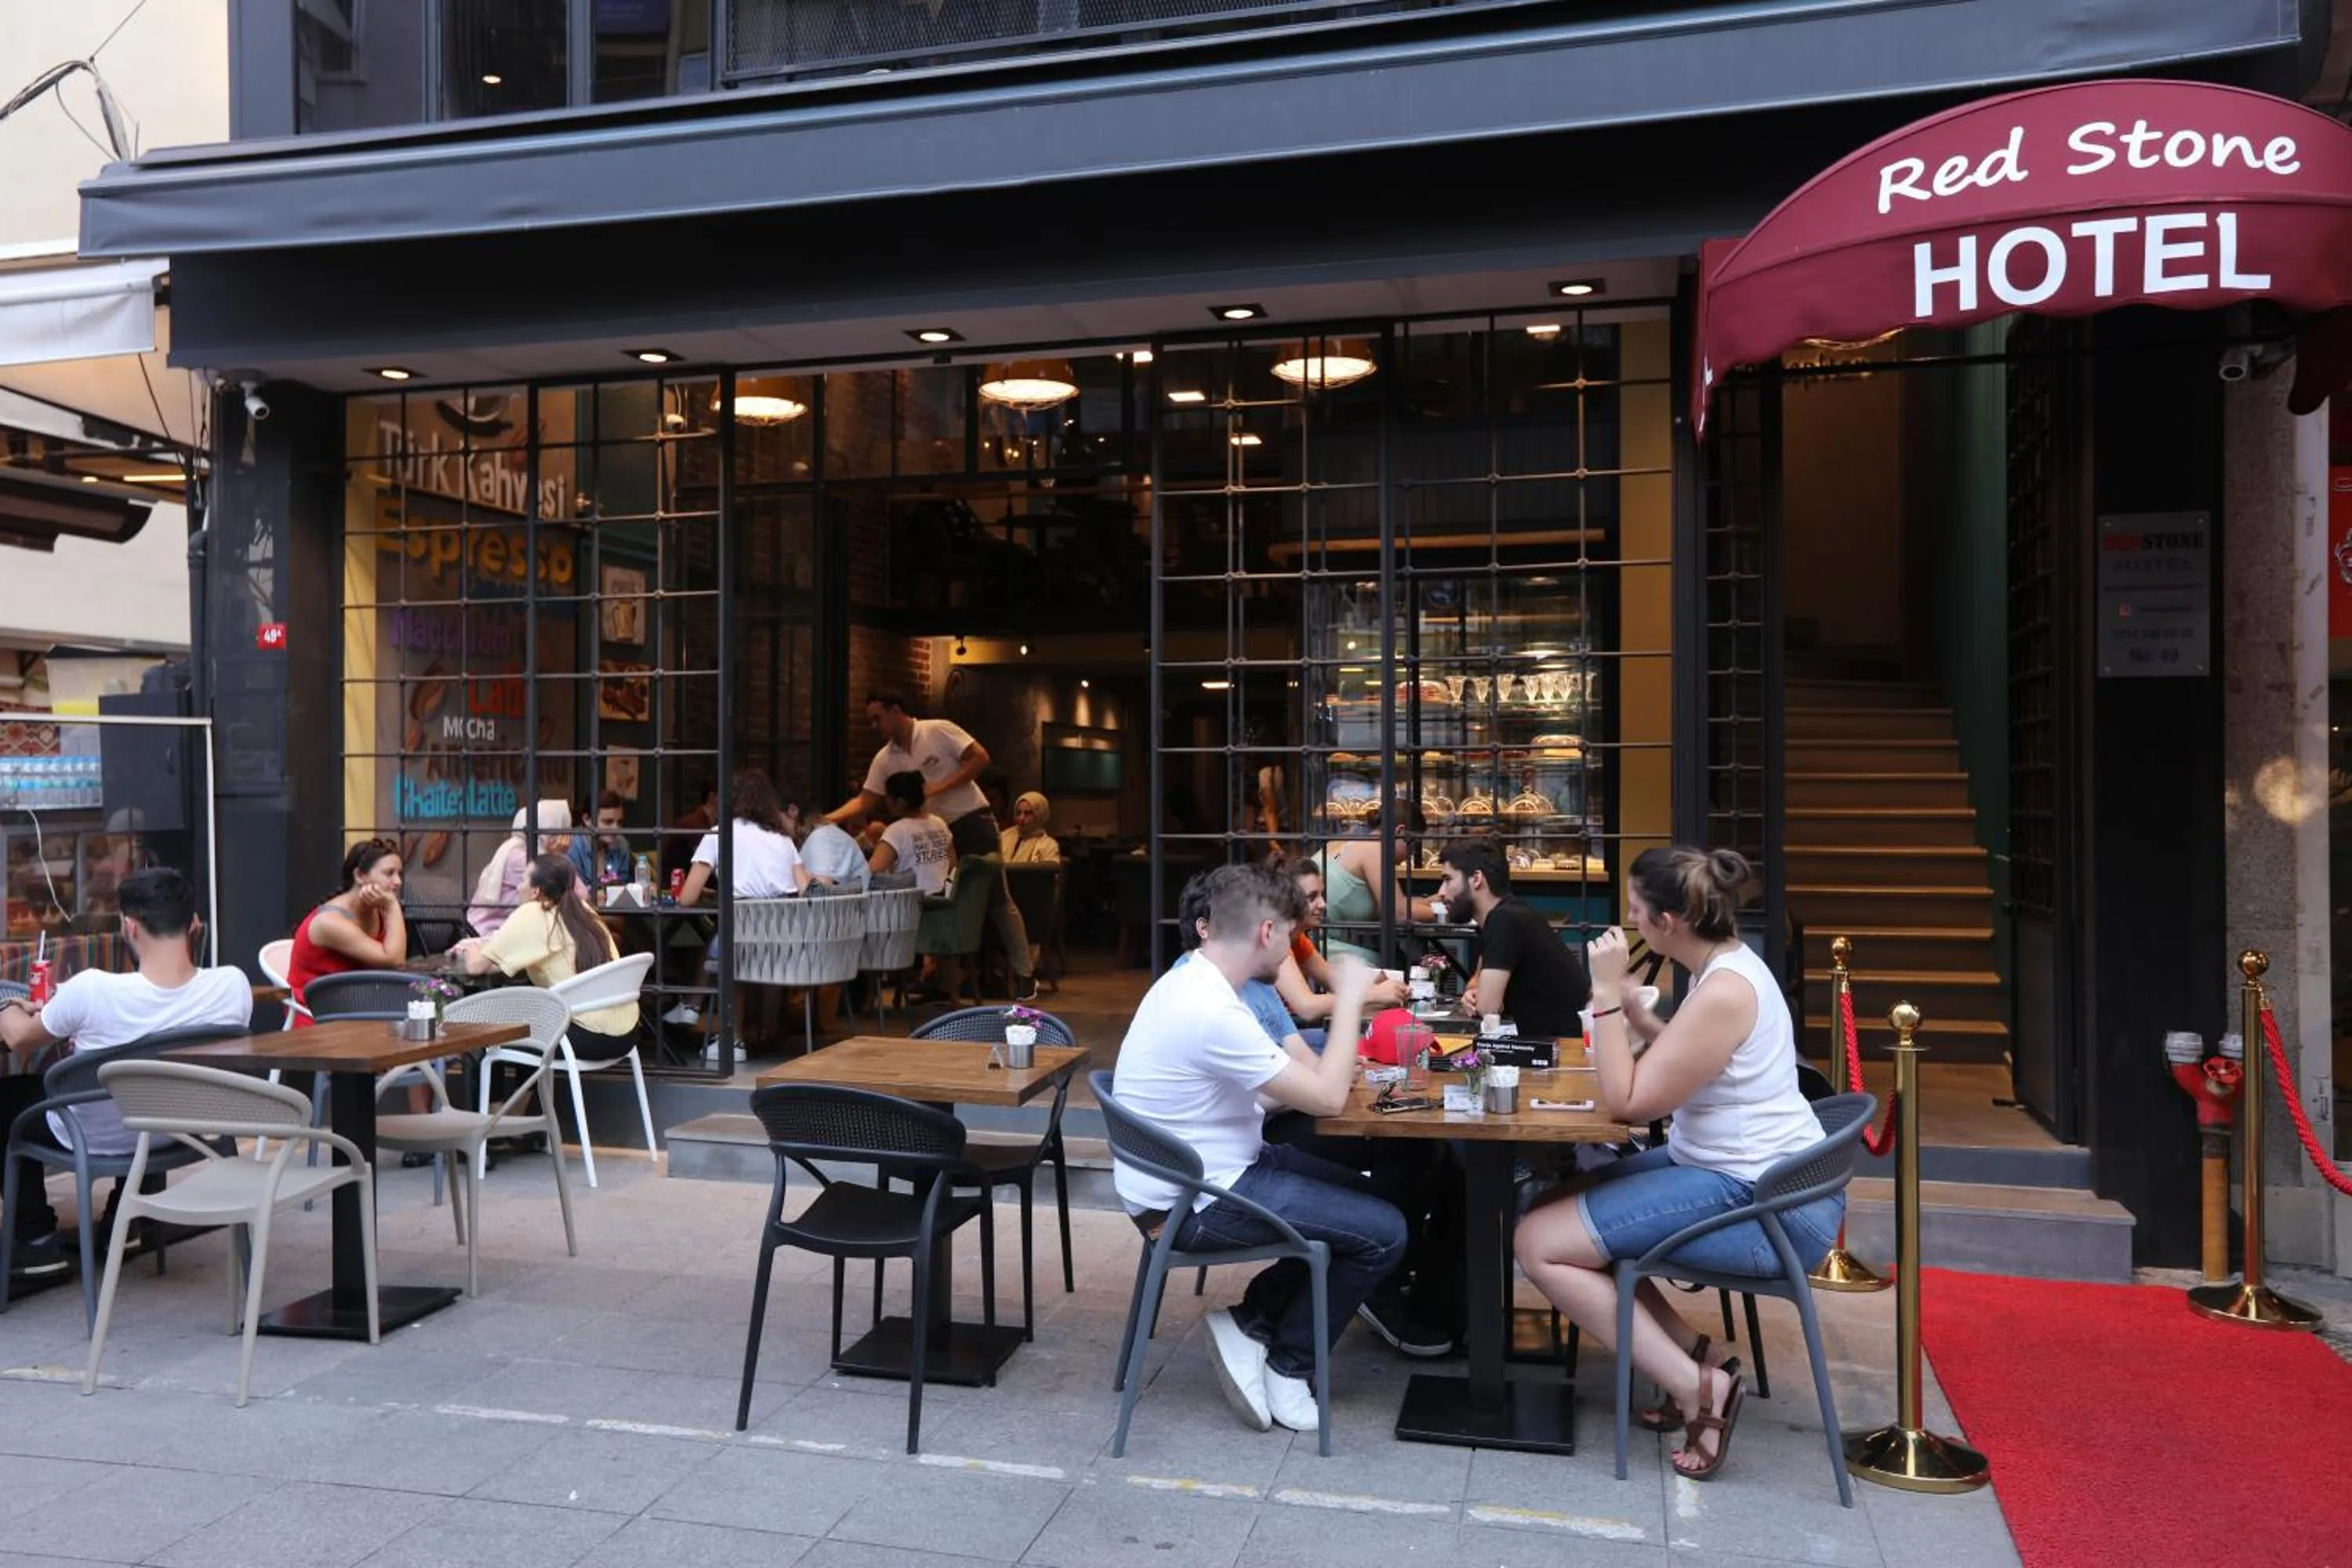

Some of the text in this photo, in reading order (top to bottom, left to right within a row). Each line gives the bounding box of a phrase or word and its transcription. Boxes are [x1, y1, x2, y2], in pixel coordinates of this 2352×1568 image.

[1878, 118, 2302, 213] Red Stone
[1913, 212, 2272, 318] HOTEL
